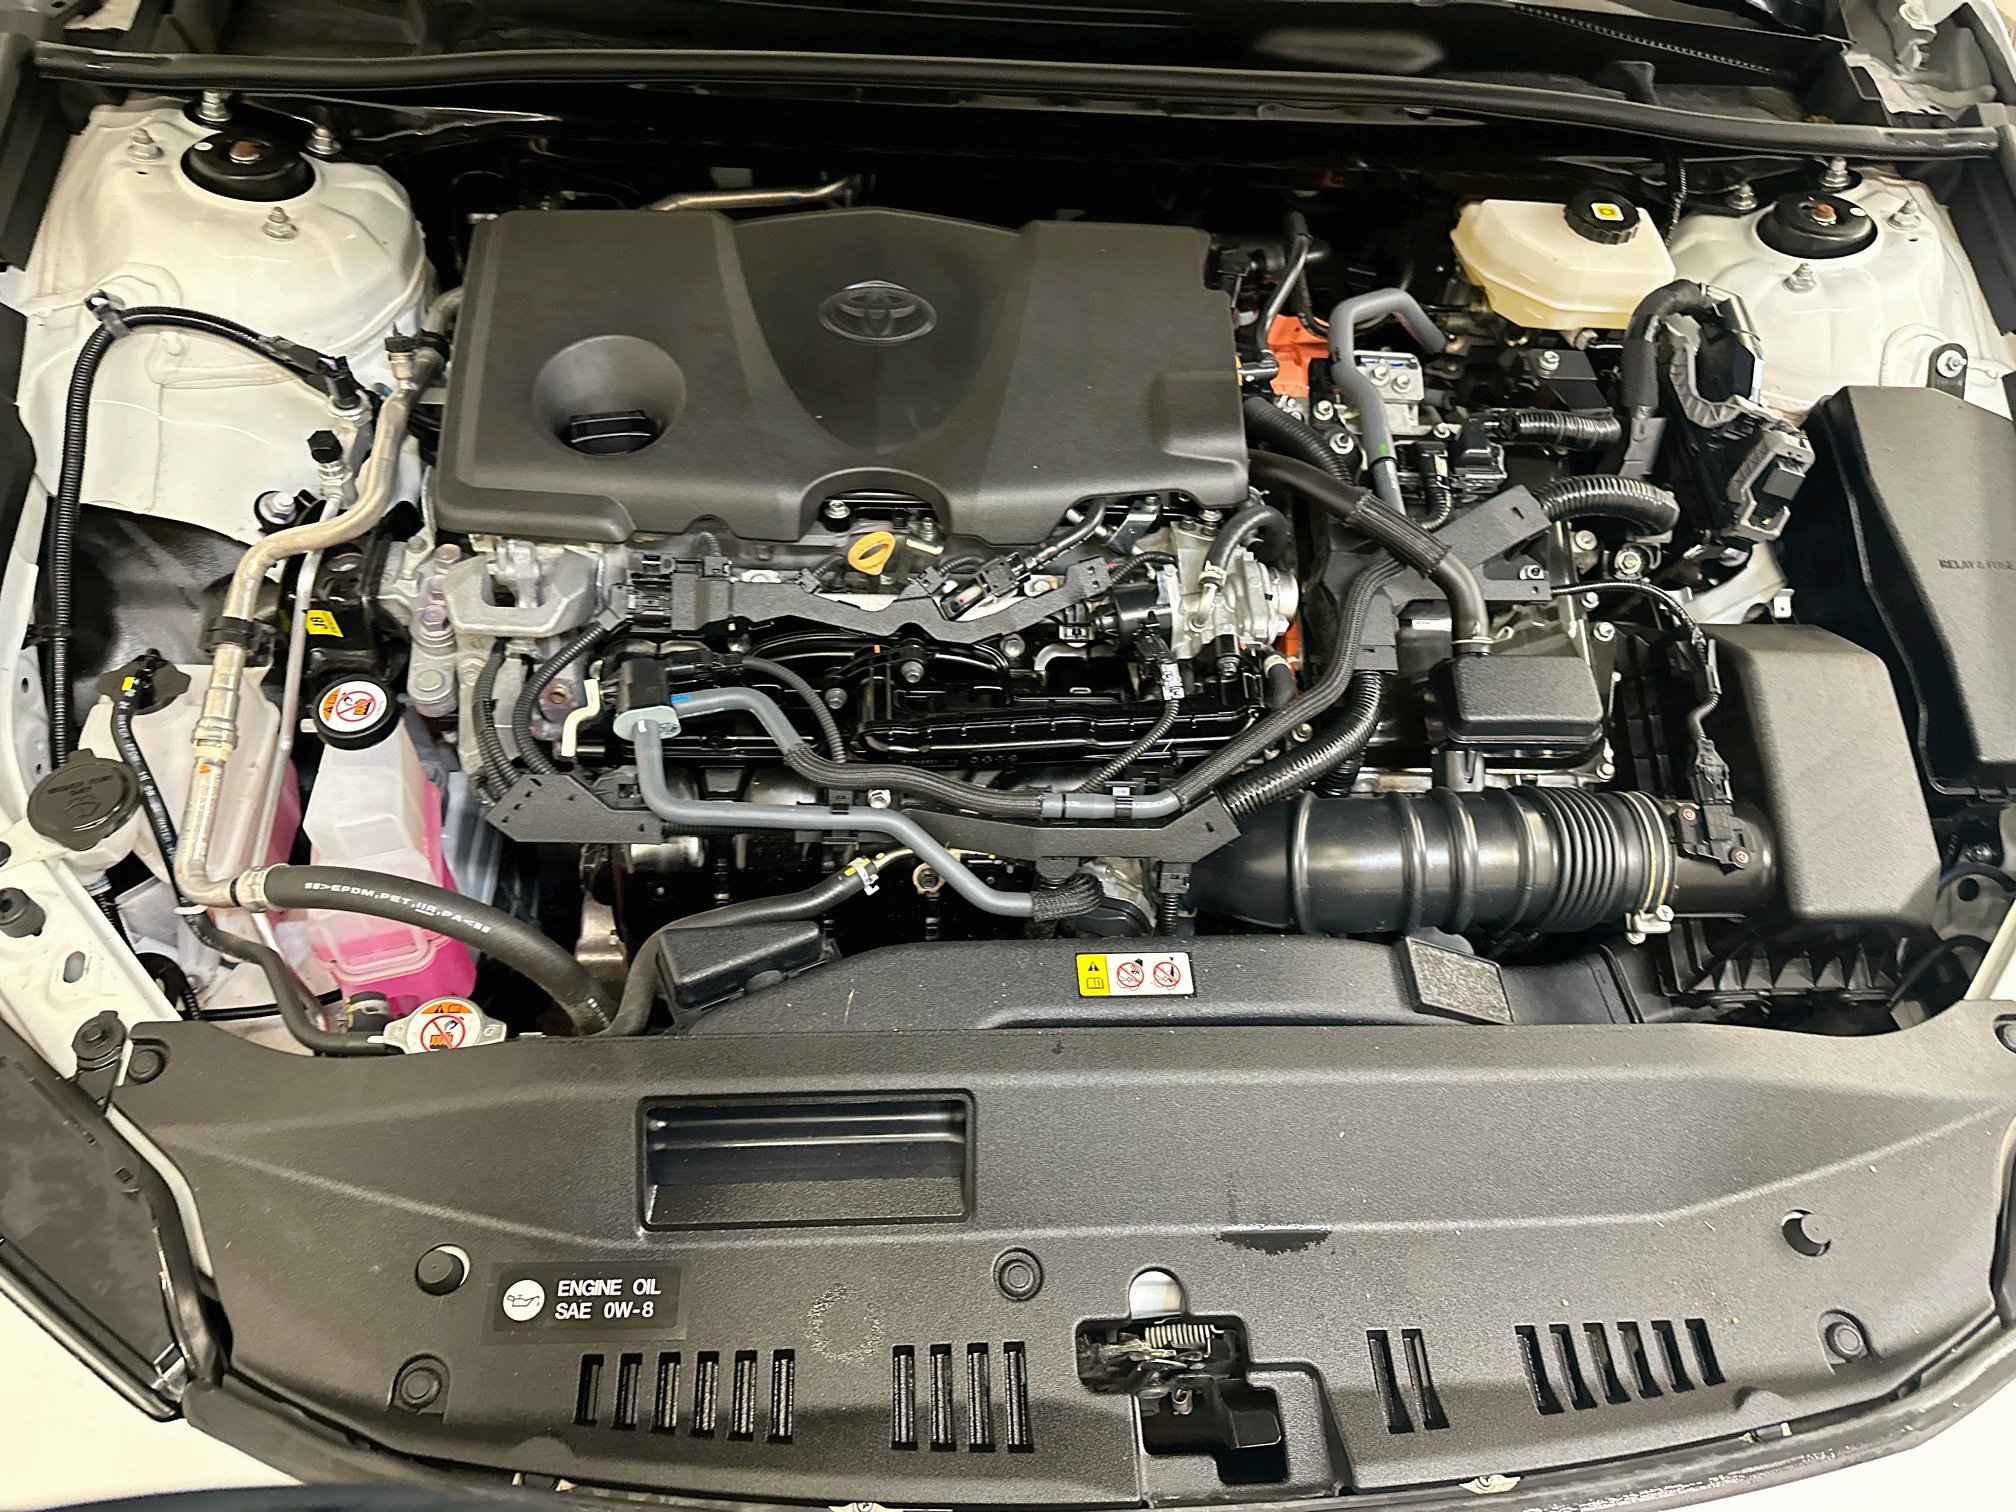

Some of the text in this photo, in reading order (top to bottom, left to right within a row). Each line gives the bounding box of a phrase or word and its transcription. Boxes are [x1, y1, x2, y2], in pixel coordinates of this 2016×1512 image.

[557, 1278, 661, 1297] ENGINE OIL
[554, 1300, 654, 1320] SAE 0W-8
